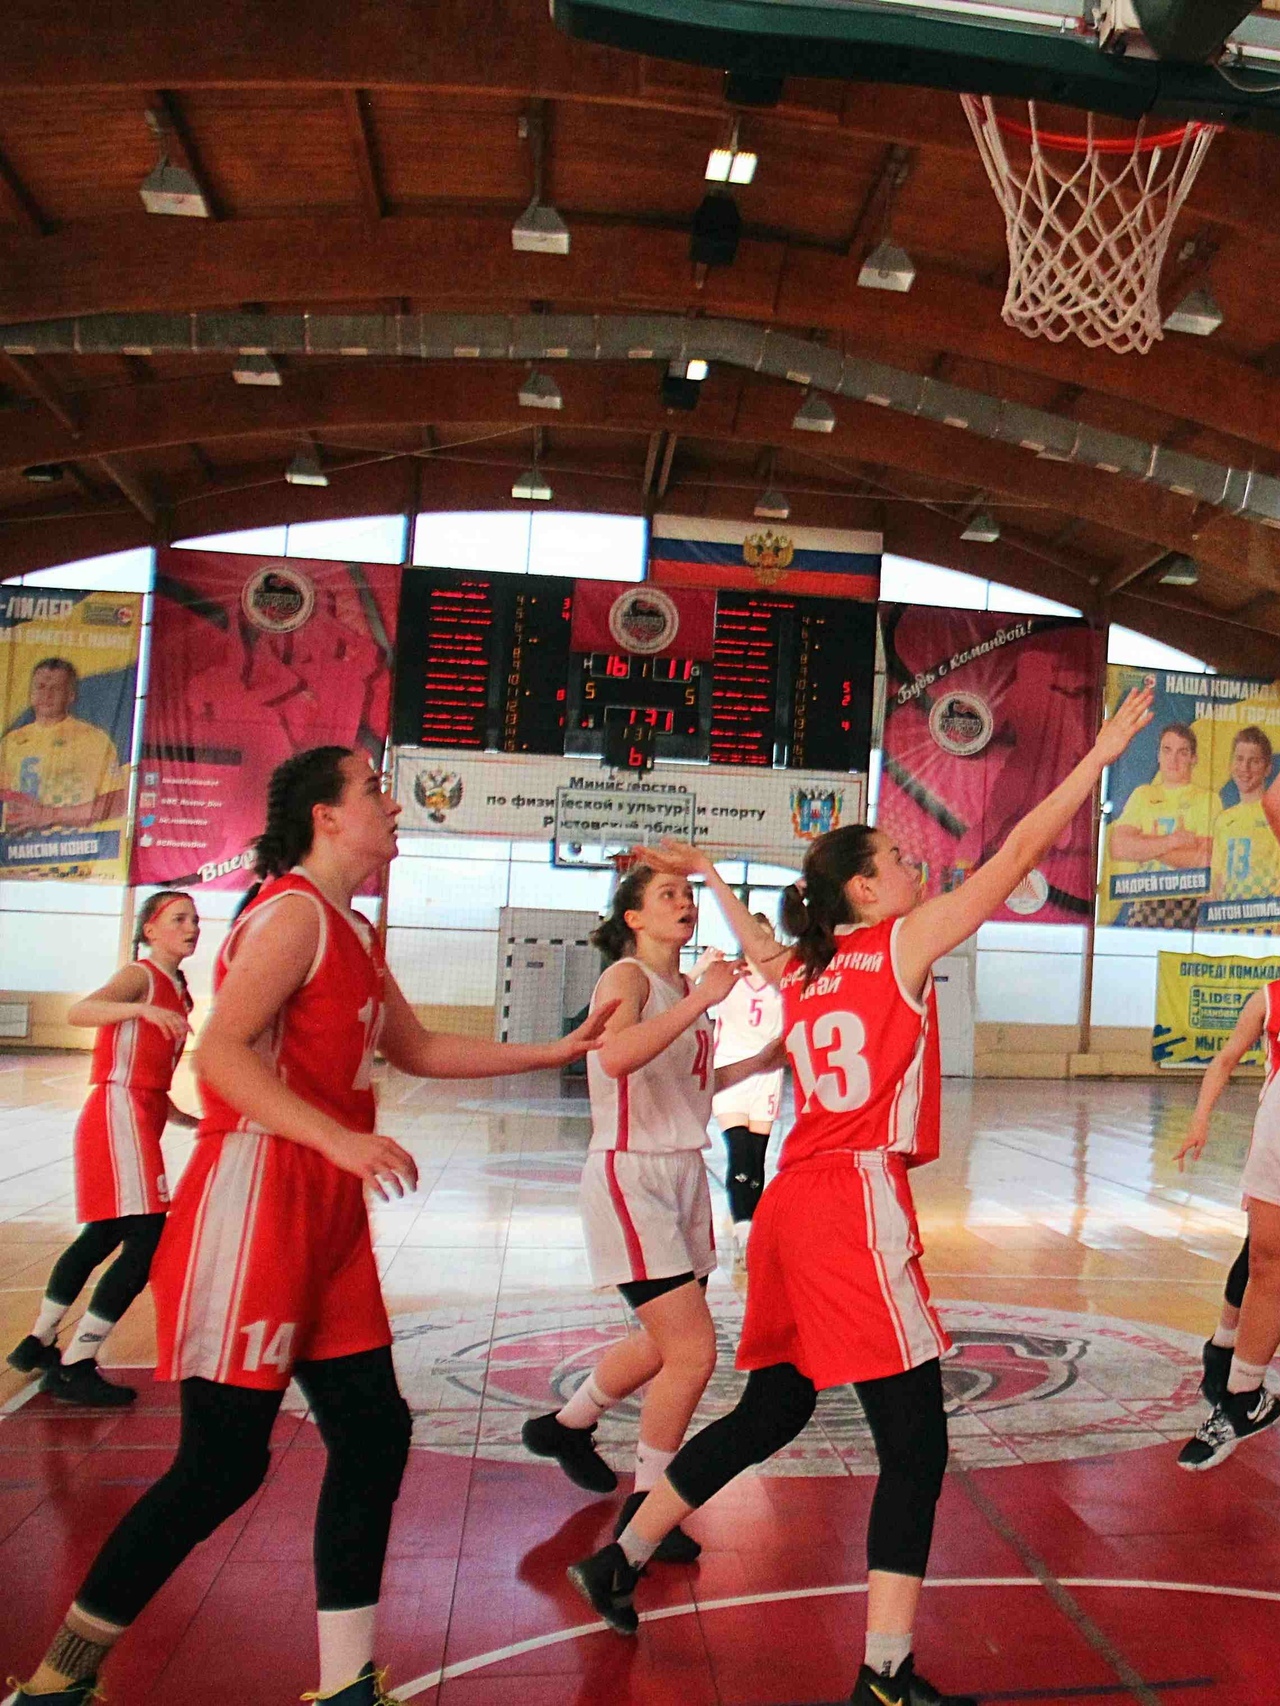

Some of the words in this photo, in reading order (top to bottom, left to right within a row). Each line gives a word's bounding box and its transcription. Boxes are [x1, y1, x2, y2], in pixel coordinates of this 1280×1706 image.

[606, 655, 628, 677] 16
[668, 658, 694, 680] 11
[585, 681, 596, 699] 5
[685, 687, 695, 705] 5
[897, 673, 935, 705] Будь
[938, 665, 948, 676] с
[1165, 675, 1208, 697] НАША
[1195, 702, 1236, 721] НАША
[486, 795, 506, 806] по
[511, 794, 613, 811] физиеской
[696, 805, 706, 816] и
[710, 806, 766, 821] спорту
[8, 843, 58, 861] МАКСИМ
[60, 839, 99, 857] КОНЕВ
[1226, 837, 1251, 880] 13
[1115, 877, 1158, 895] АНДРЕЙ
[1159, 874, 1207, 892] ГОРДЕЕВ
[1208, 904, 1242, 921] АНТОН
[1180, 962, 1227, 979] ВПЕРЕД!
[1192, 988, 1201, 1026] CLUB
[1201, 992, 1242, 1005] LIDER
[749, 999, 763, 1027] 5
[786, 1010, 871, 1114] 13
[768, 1094, 776, 1116] 5
[240, 1319, 297, 1373] 14
